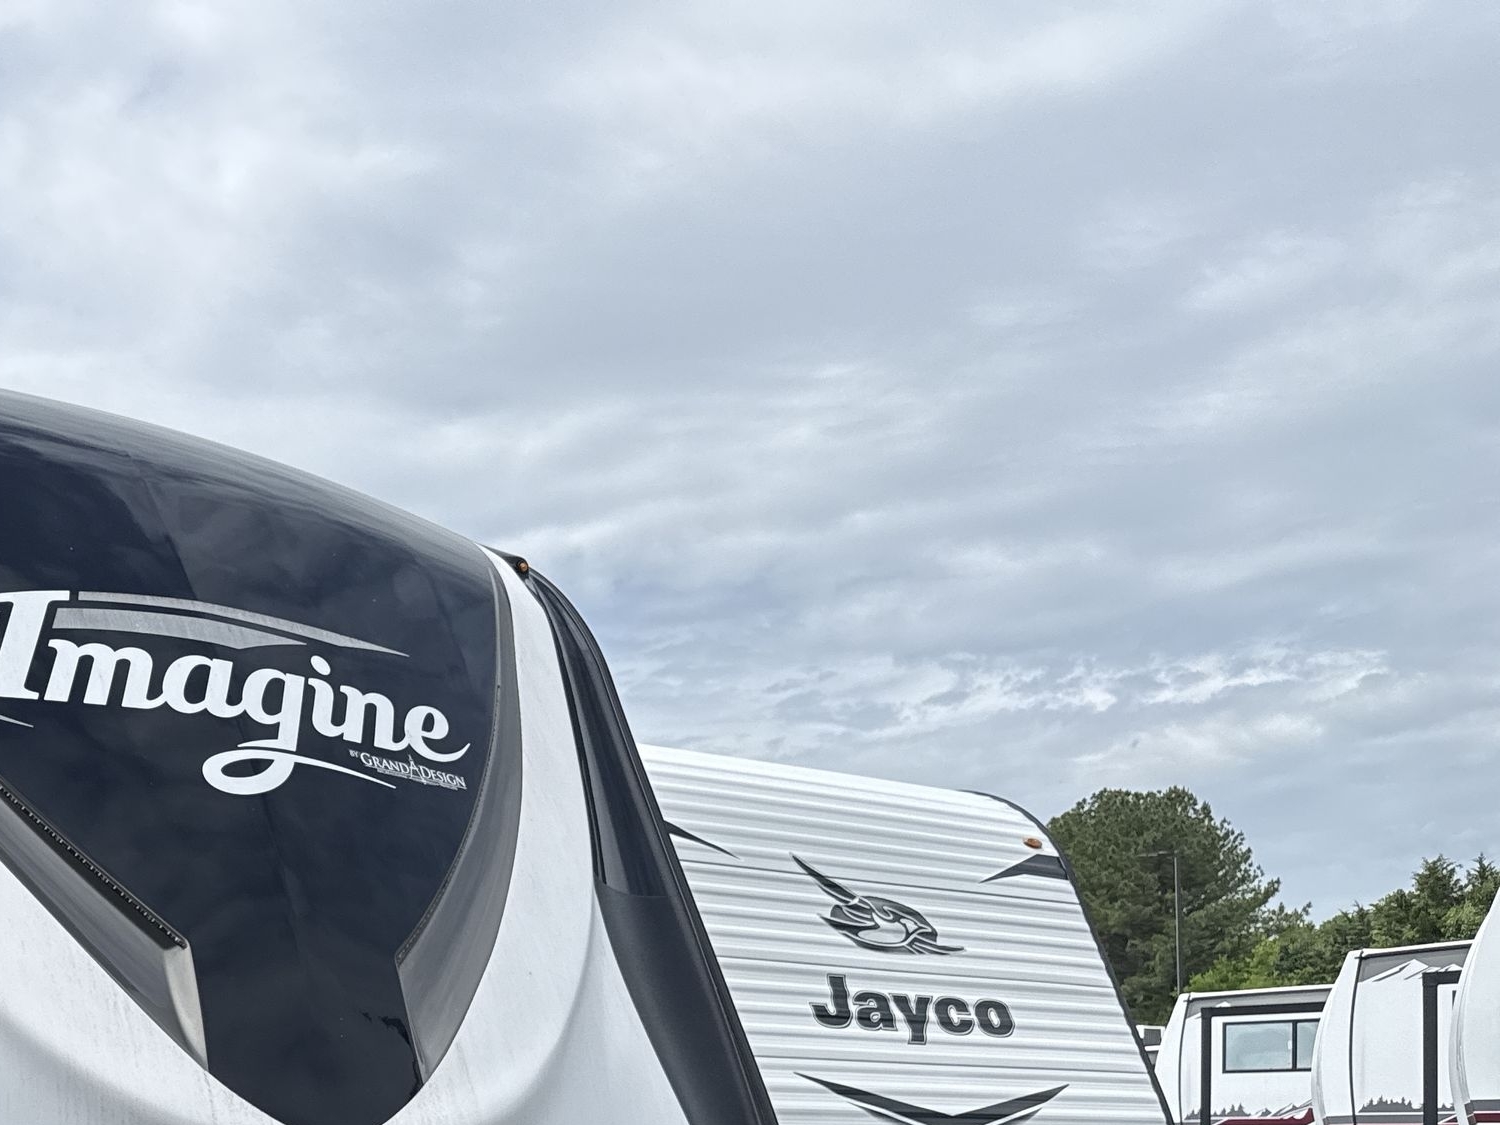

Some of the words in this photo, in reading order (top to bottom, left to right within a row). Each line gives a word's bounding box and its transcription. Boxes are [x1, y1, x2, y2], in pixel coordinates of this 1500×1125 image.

[360, 752, 410, 774] GRAND
[418, 765, 467, 788] DESIGN
[808, 973, 1015, 1045] Jayco
